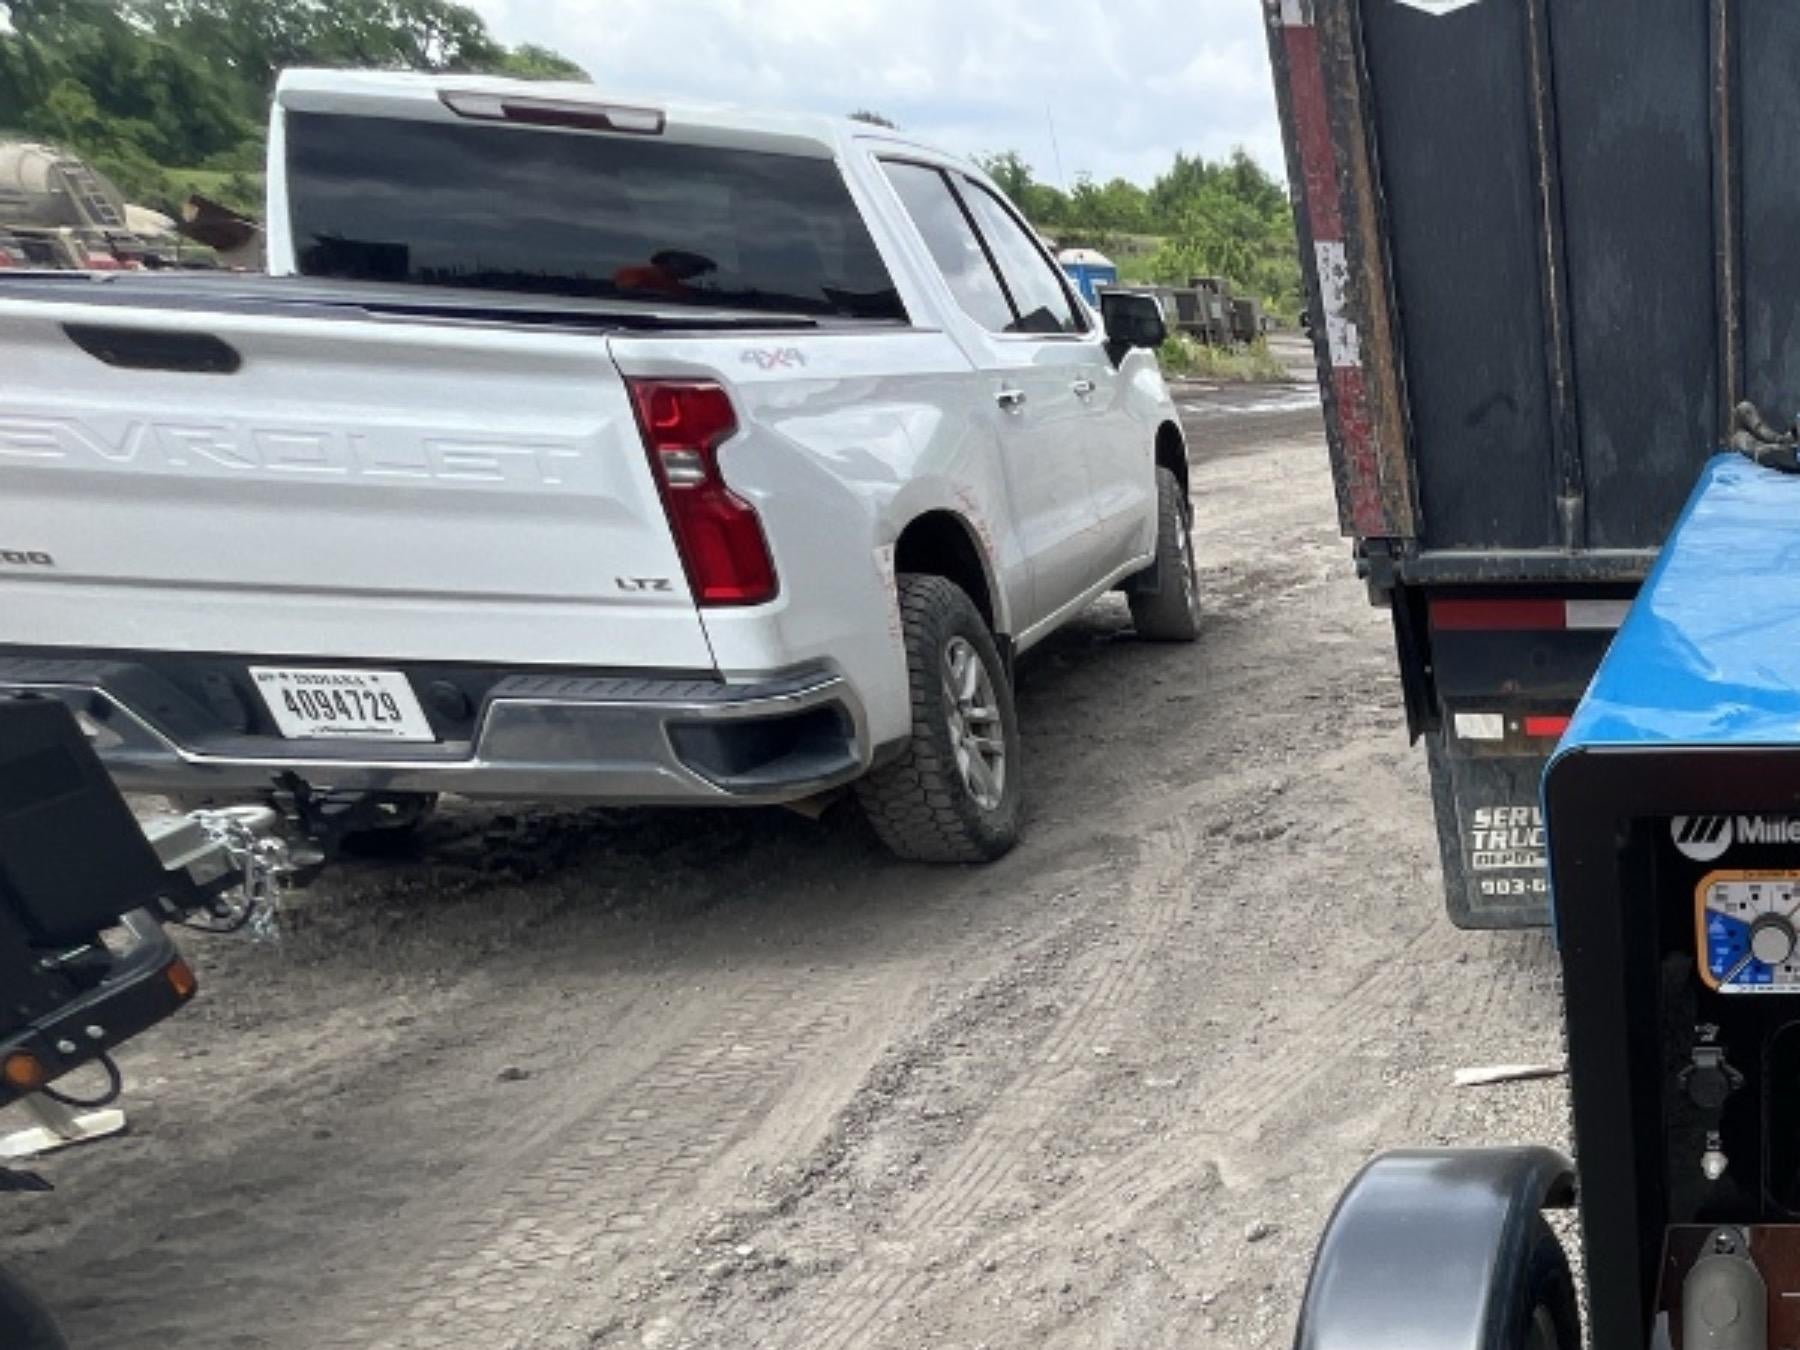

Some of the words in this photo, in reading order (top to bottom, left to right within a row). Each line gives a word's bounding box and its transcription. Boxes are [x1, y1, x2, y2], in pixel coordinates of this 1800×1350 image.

[0, 548, 55, 568] 00
[614, 577, 674, 592] LTZ
[282, 688, 403, 722] 4094729
